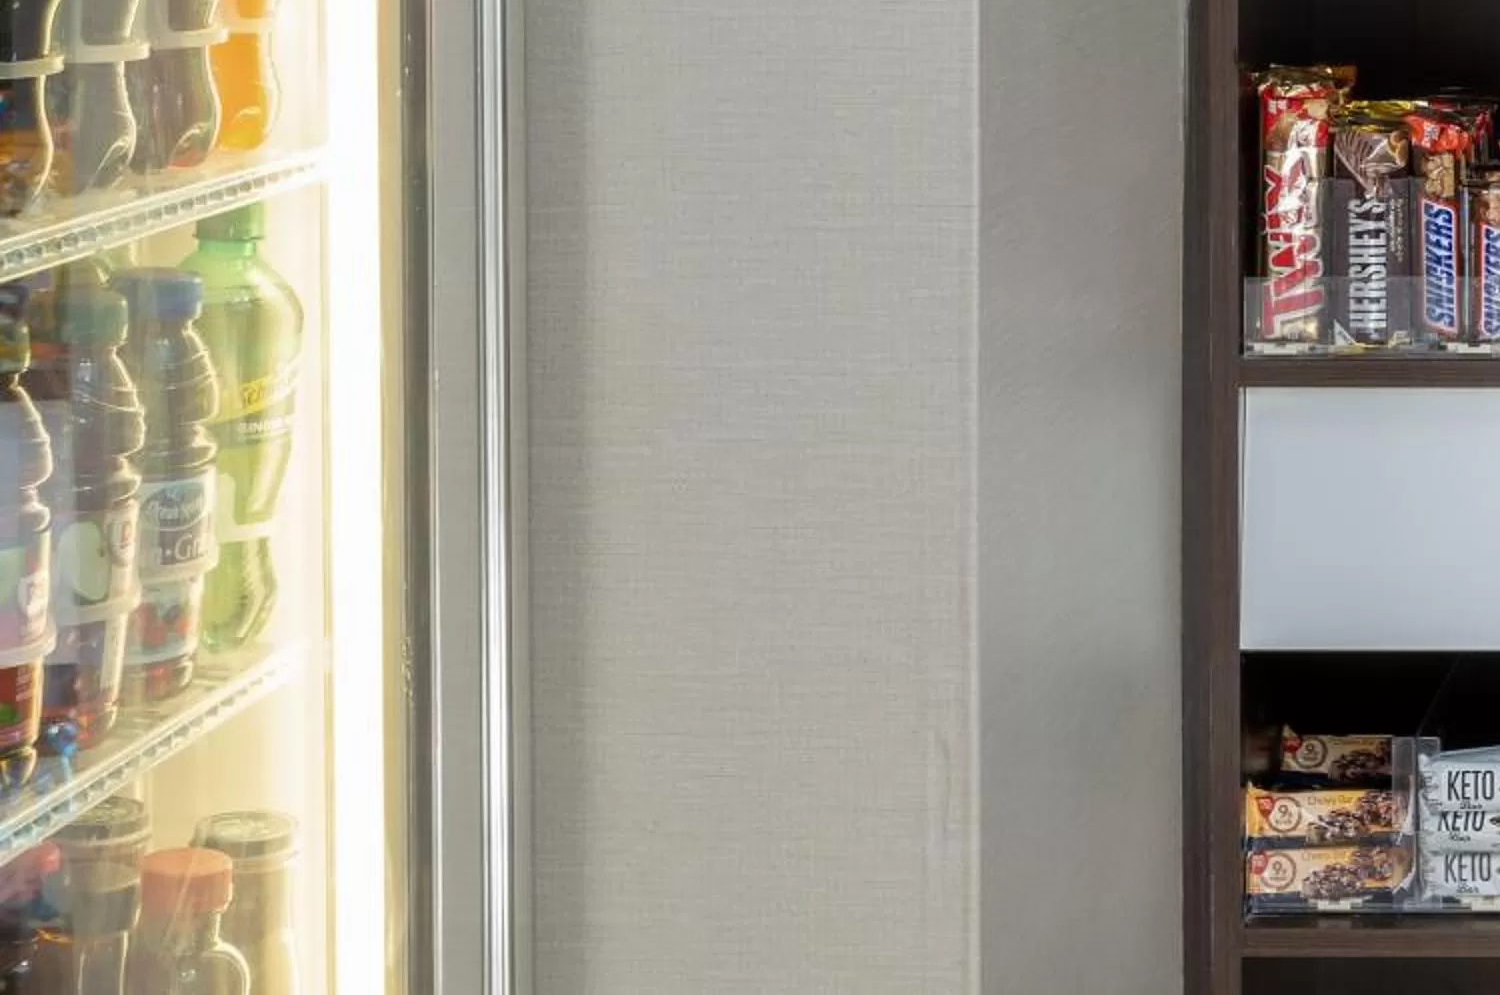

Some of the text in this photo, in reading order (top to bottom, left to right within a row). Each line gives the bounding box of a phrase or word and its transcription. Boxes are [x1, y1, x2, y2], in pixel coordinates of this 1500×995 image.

[1423, 200, 1456, 329] SNICKERS
[1446, 769, 1496, 802] KETO
[1437, 810, 1486, 832] KETO
[1443, 851, 1492, 884] KETO
